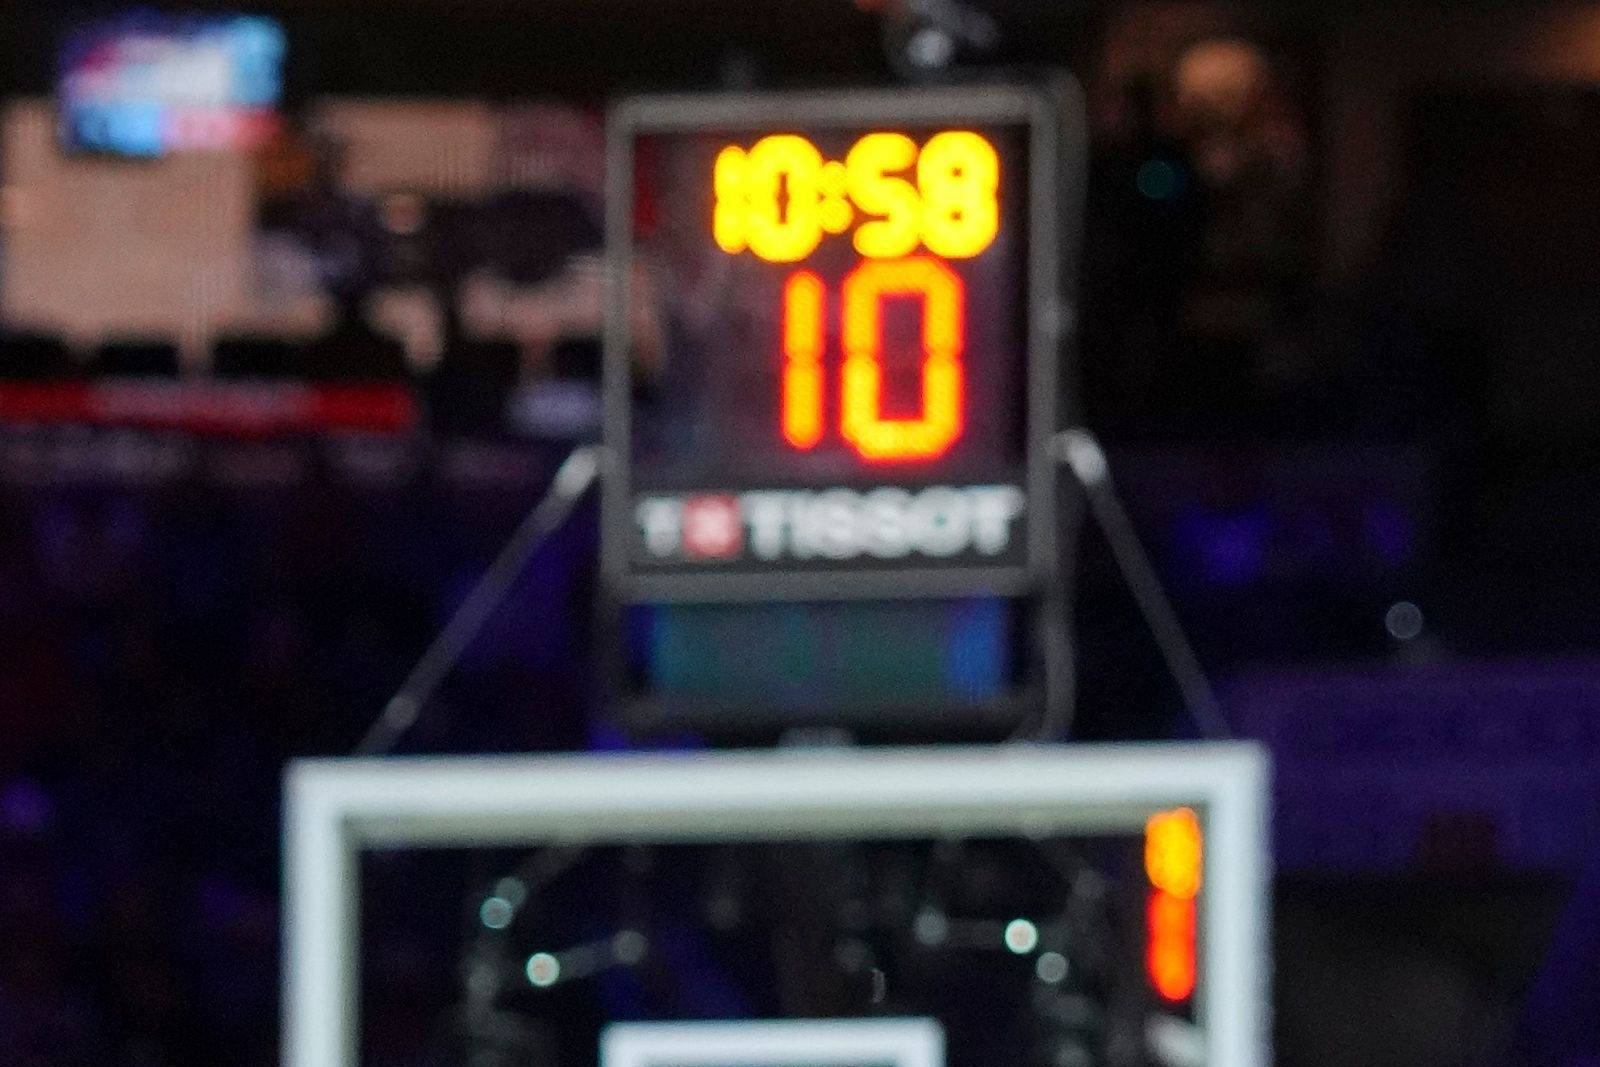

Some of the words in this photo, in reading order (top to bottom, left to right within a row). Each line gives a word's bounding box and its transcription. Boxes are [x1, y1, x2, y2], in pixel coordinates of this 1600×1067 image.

[714, 130, 998, 262] 10:58
[781, 256, 963, 463] 10
[739, 486, 1023, 561] TISSOT
